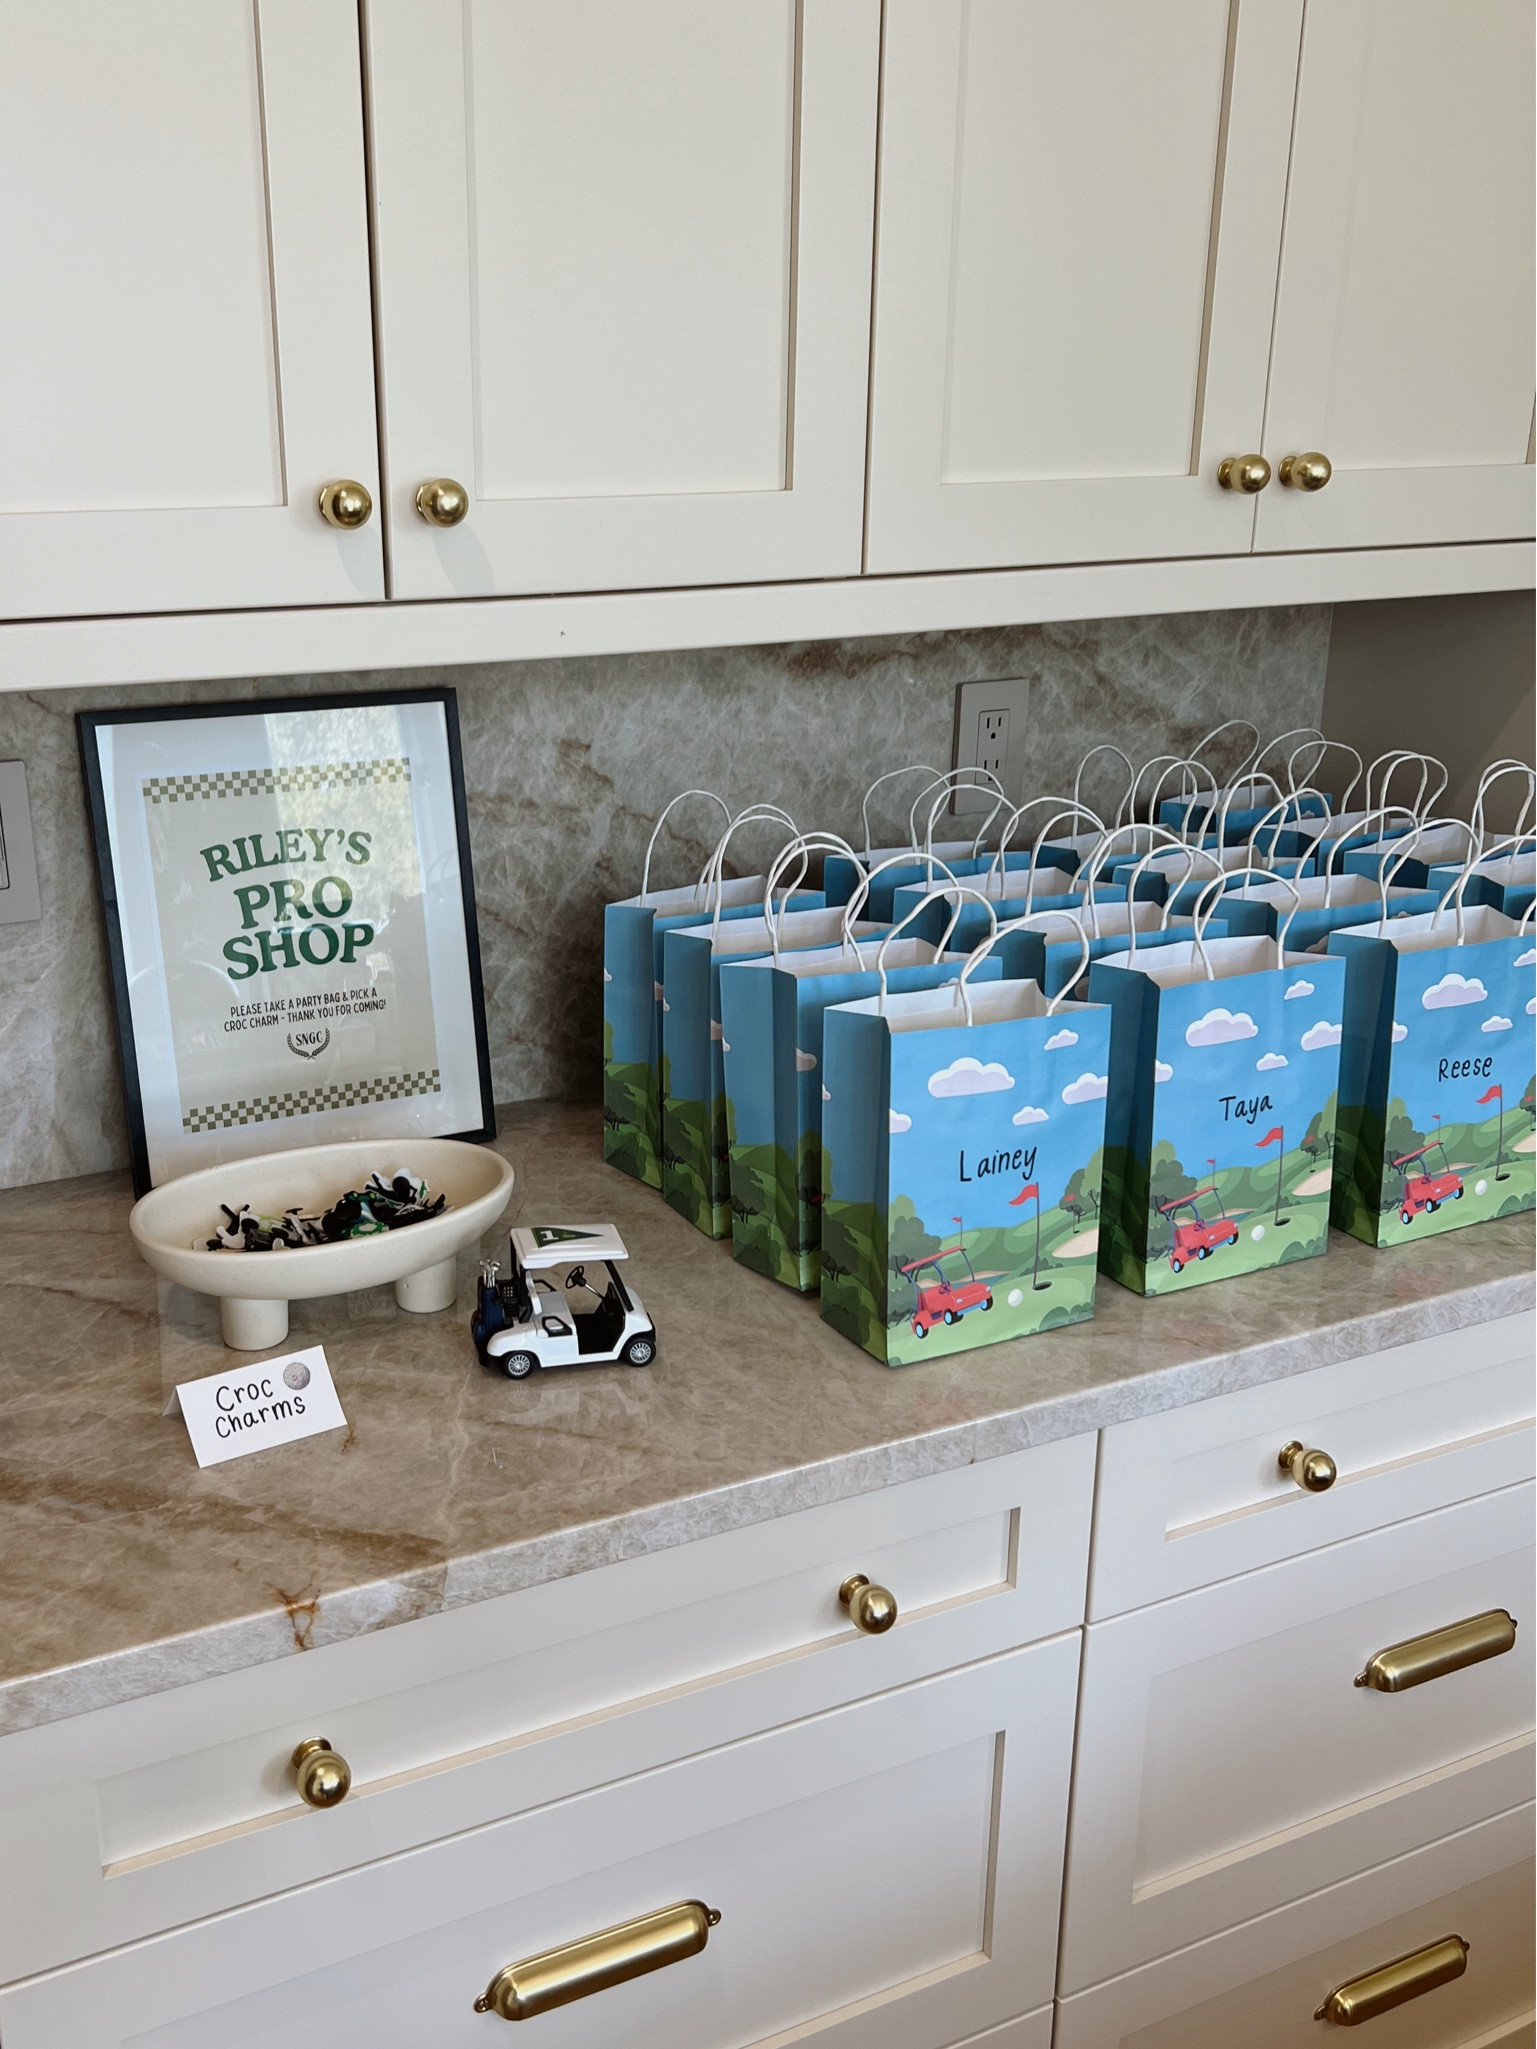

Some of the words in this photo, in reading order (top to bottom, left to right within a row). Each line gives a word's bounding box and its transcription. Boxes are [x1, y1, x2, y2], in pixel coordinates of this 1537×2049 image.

[200, 828, 372, 882] RILEY'S
[233, 876, 353, 929] PRO
[223, 923, 374, 980] SHOP
[224, 1018, 247, 1032] CROC
[250, 1014, 279, 1029] CHARM
[287, 1008, 315, 1023] THANK
[317, 1006, 334, 1019] YOU
[335, 1004, 351, 1016] FOR
[353, 999, 387, 1014] COMING!
[230, 1003, 262, 1018] PLEASE
[264, 1000, 286, 1013] TAKE
[288, 999, 295, 1010] A
[296, 995, 322, 1008] PARTY
[324, 992, 340, 1005] BAG
[342, 991, 349, 1001] &
[350, 988, 369, 1000] PICK
[371, 987, 378, 998] A
[295, 1030, 323, 1047] SNGC
[1438, 1057, 1493, 1082] Reese
[1218, 1095, 1273, 1124] Taya
[960, 1146, 1037, 1182] Lainey
[540, 1230, 559, 1241] 1
[215, 1379, 274, 1412] Croc
[215, 1396, 306, 1438] Charms
